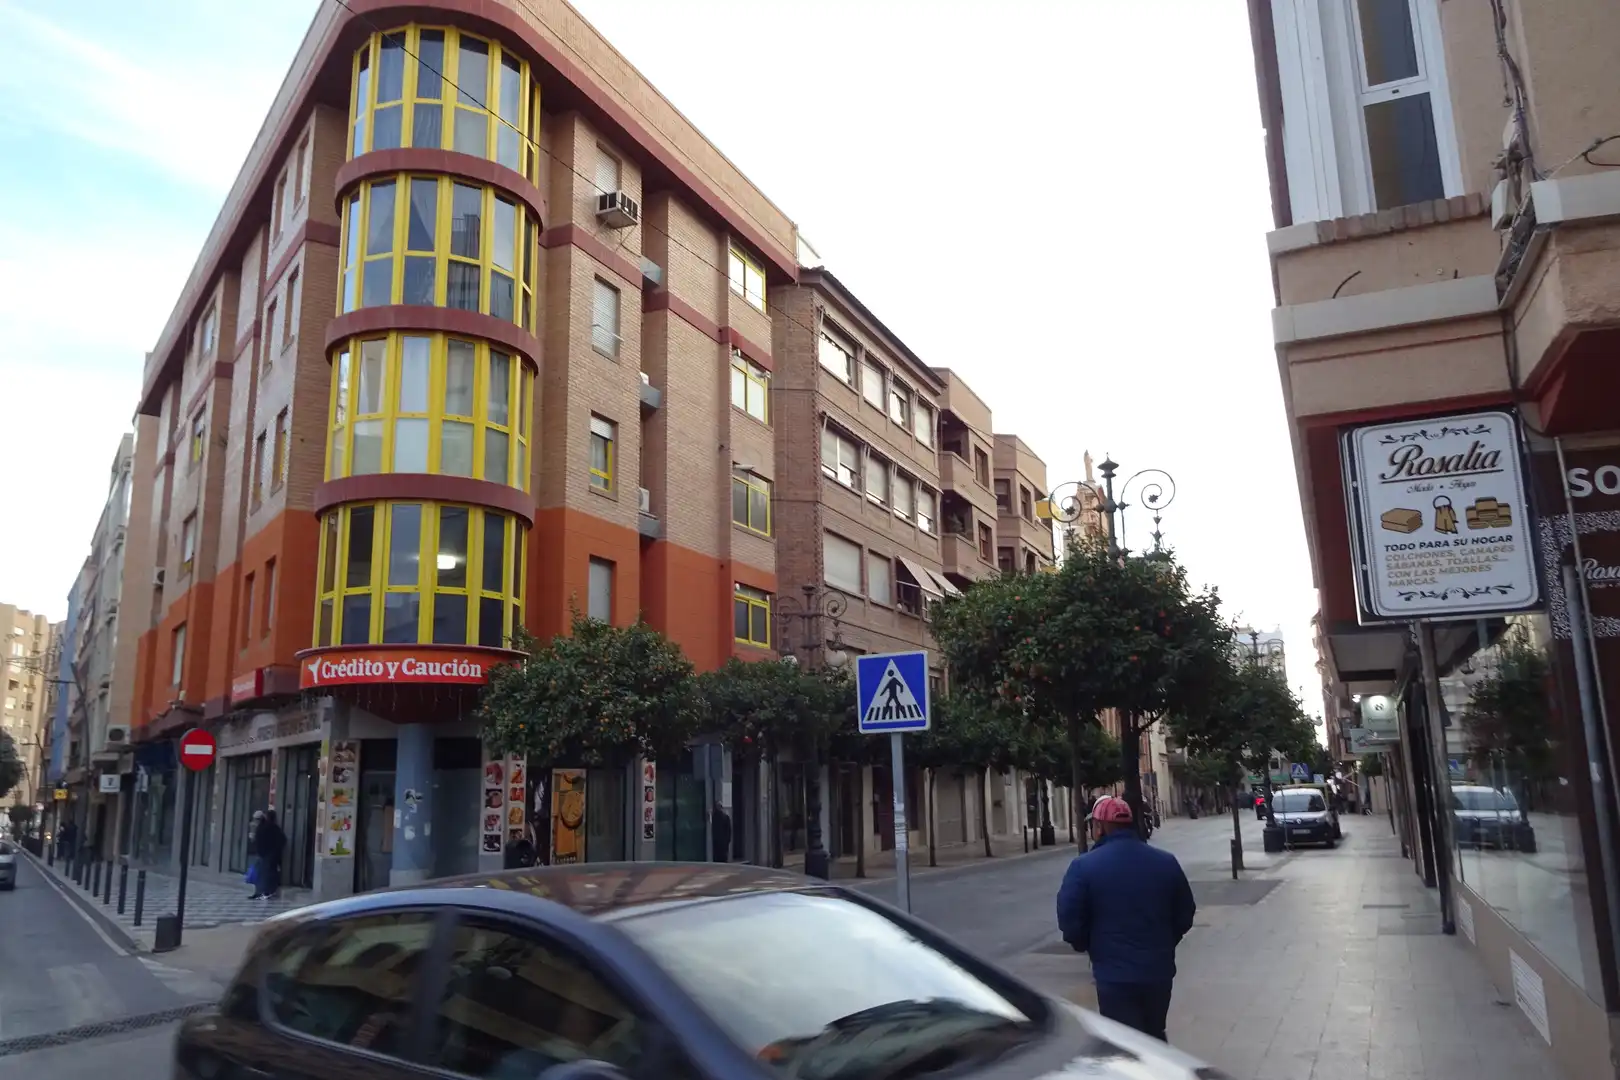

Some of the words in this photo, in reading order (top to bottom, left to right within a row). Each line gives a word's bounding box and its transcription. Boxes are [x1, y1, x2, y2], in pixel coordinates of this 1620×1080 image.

[1384, 543, 1415, 552] TODO
[1419, 540, 1450, 549] PARA
[1453, 538, 1468, 547] SU
[1471, 534, 1513, 545] HOGAR
[1387, 570, 1411, 578] CON
[1414, 568, 1436, 577] LAS
[321, 658, 384, 679] Crédito
[386, 661, 400, 679] y
[401, 657, 482, 678] Caución
